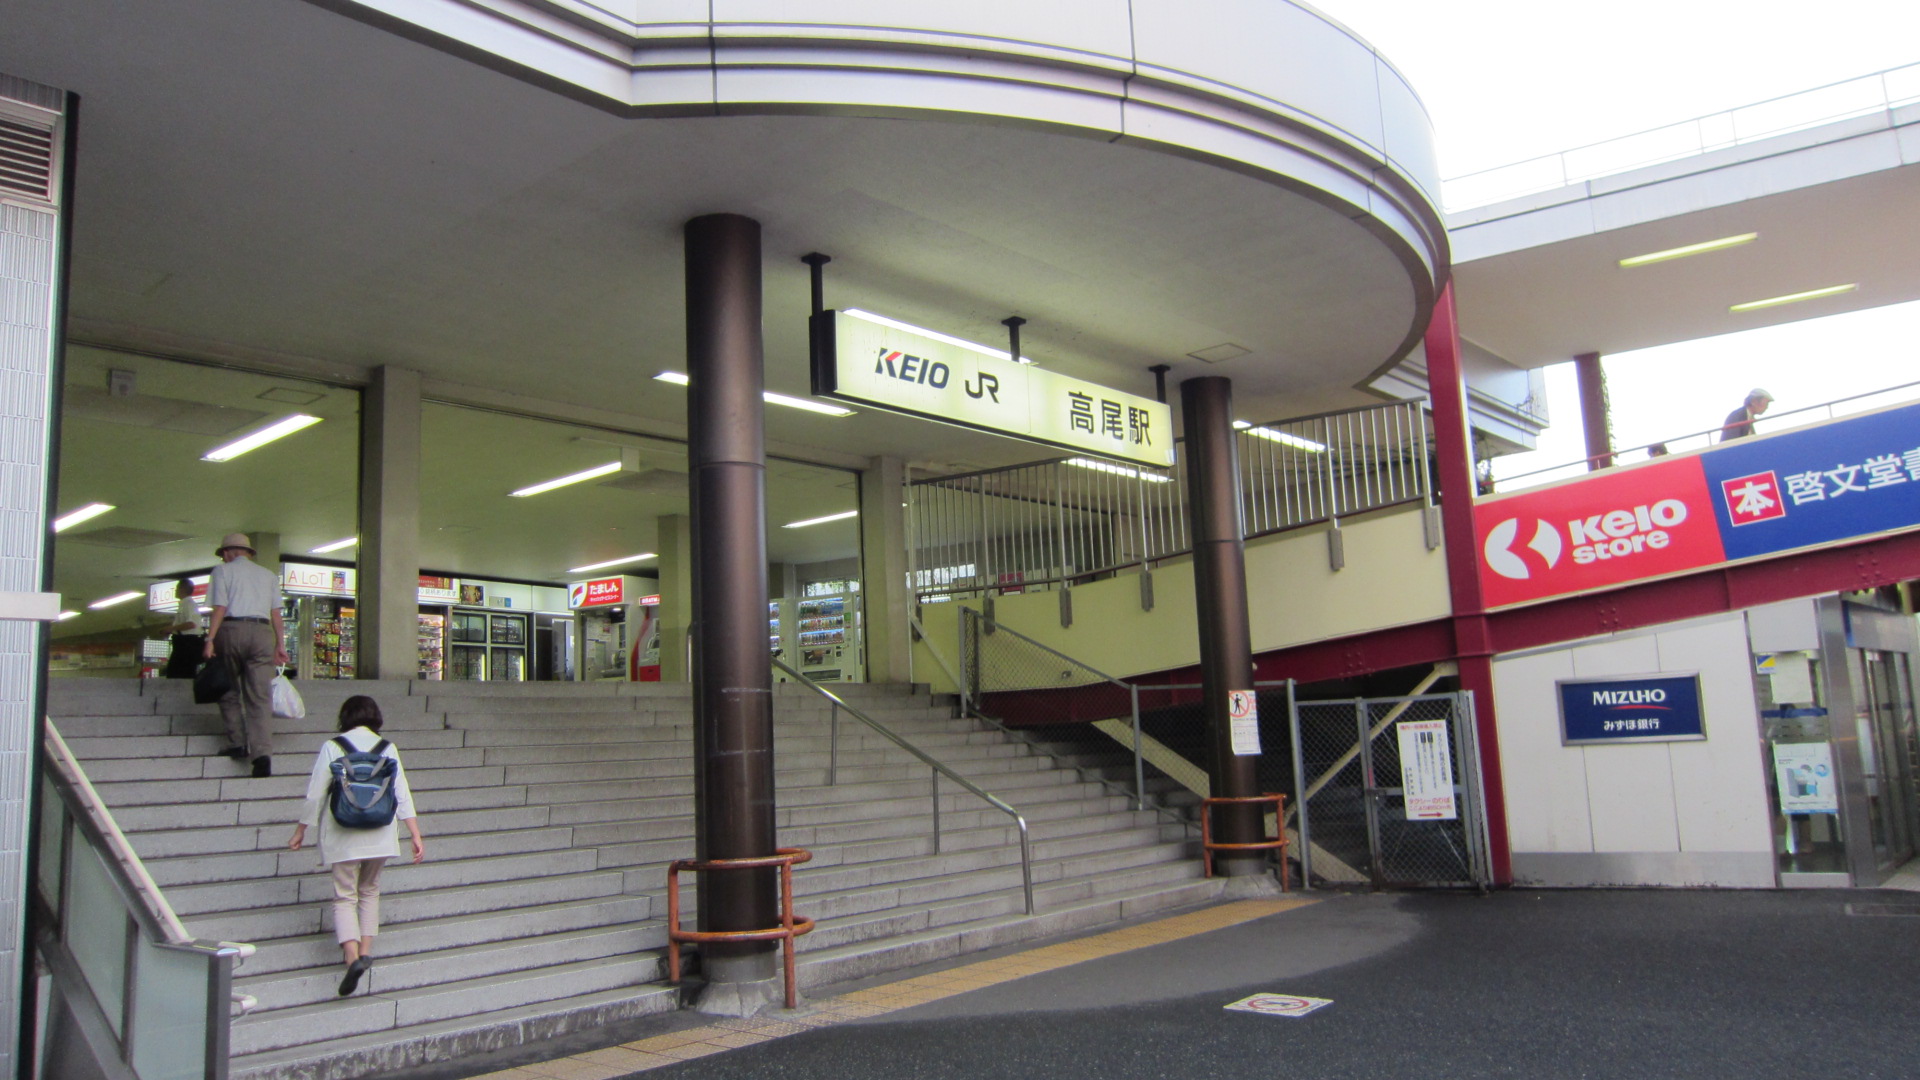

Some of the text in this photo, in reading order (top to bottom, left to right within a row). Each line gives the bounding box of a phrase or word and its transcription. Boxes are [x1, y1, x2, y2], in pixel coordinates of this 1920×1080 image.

[875, 347, 1000, 404] KEIO JR
[1068, 391, 1152, 447] 高尾駅
[1730, 481, 1775, 517] 本
[1572, 529, 1670, 565] store
[589, 581, 619, 595] たましん
[1592, 689, 1666, 706] MIZUHO
[1603, 718, 1660, 731] みずほ銀行
